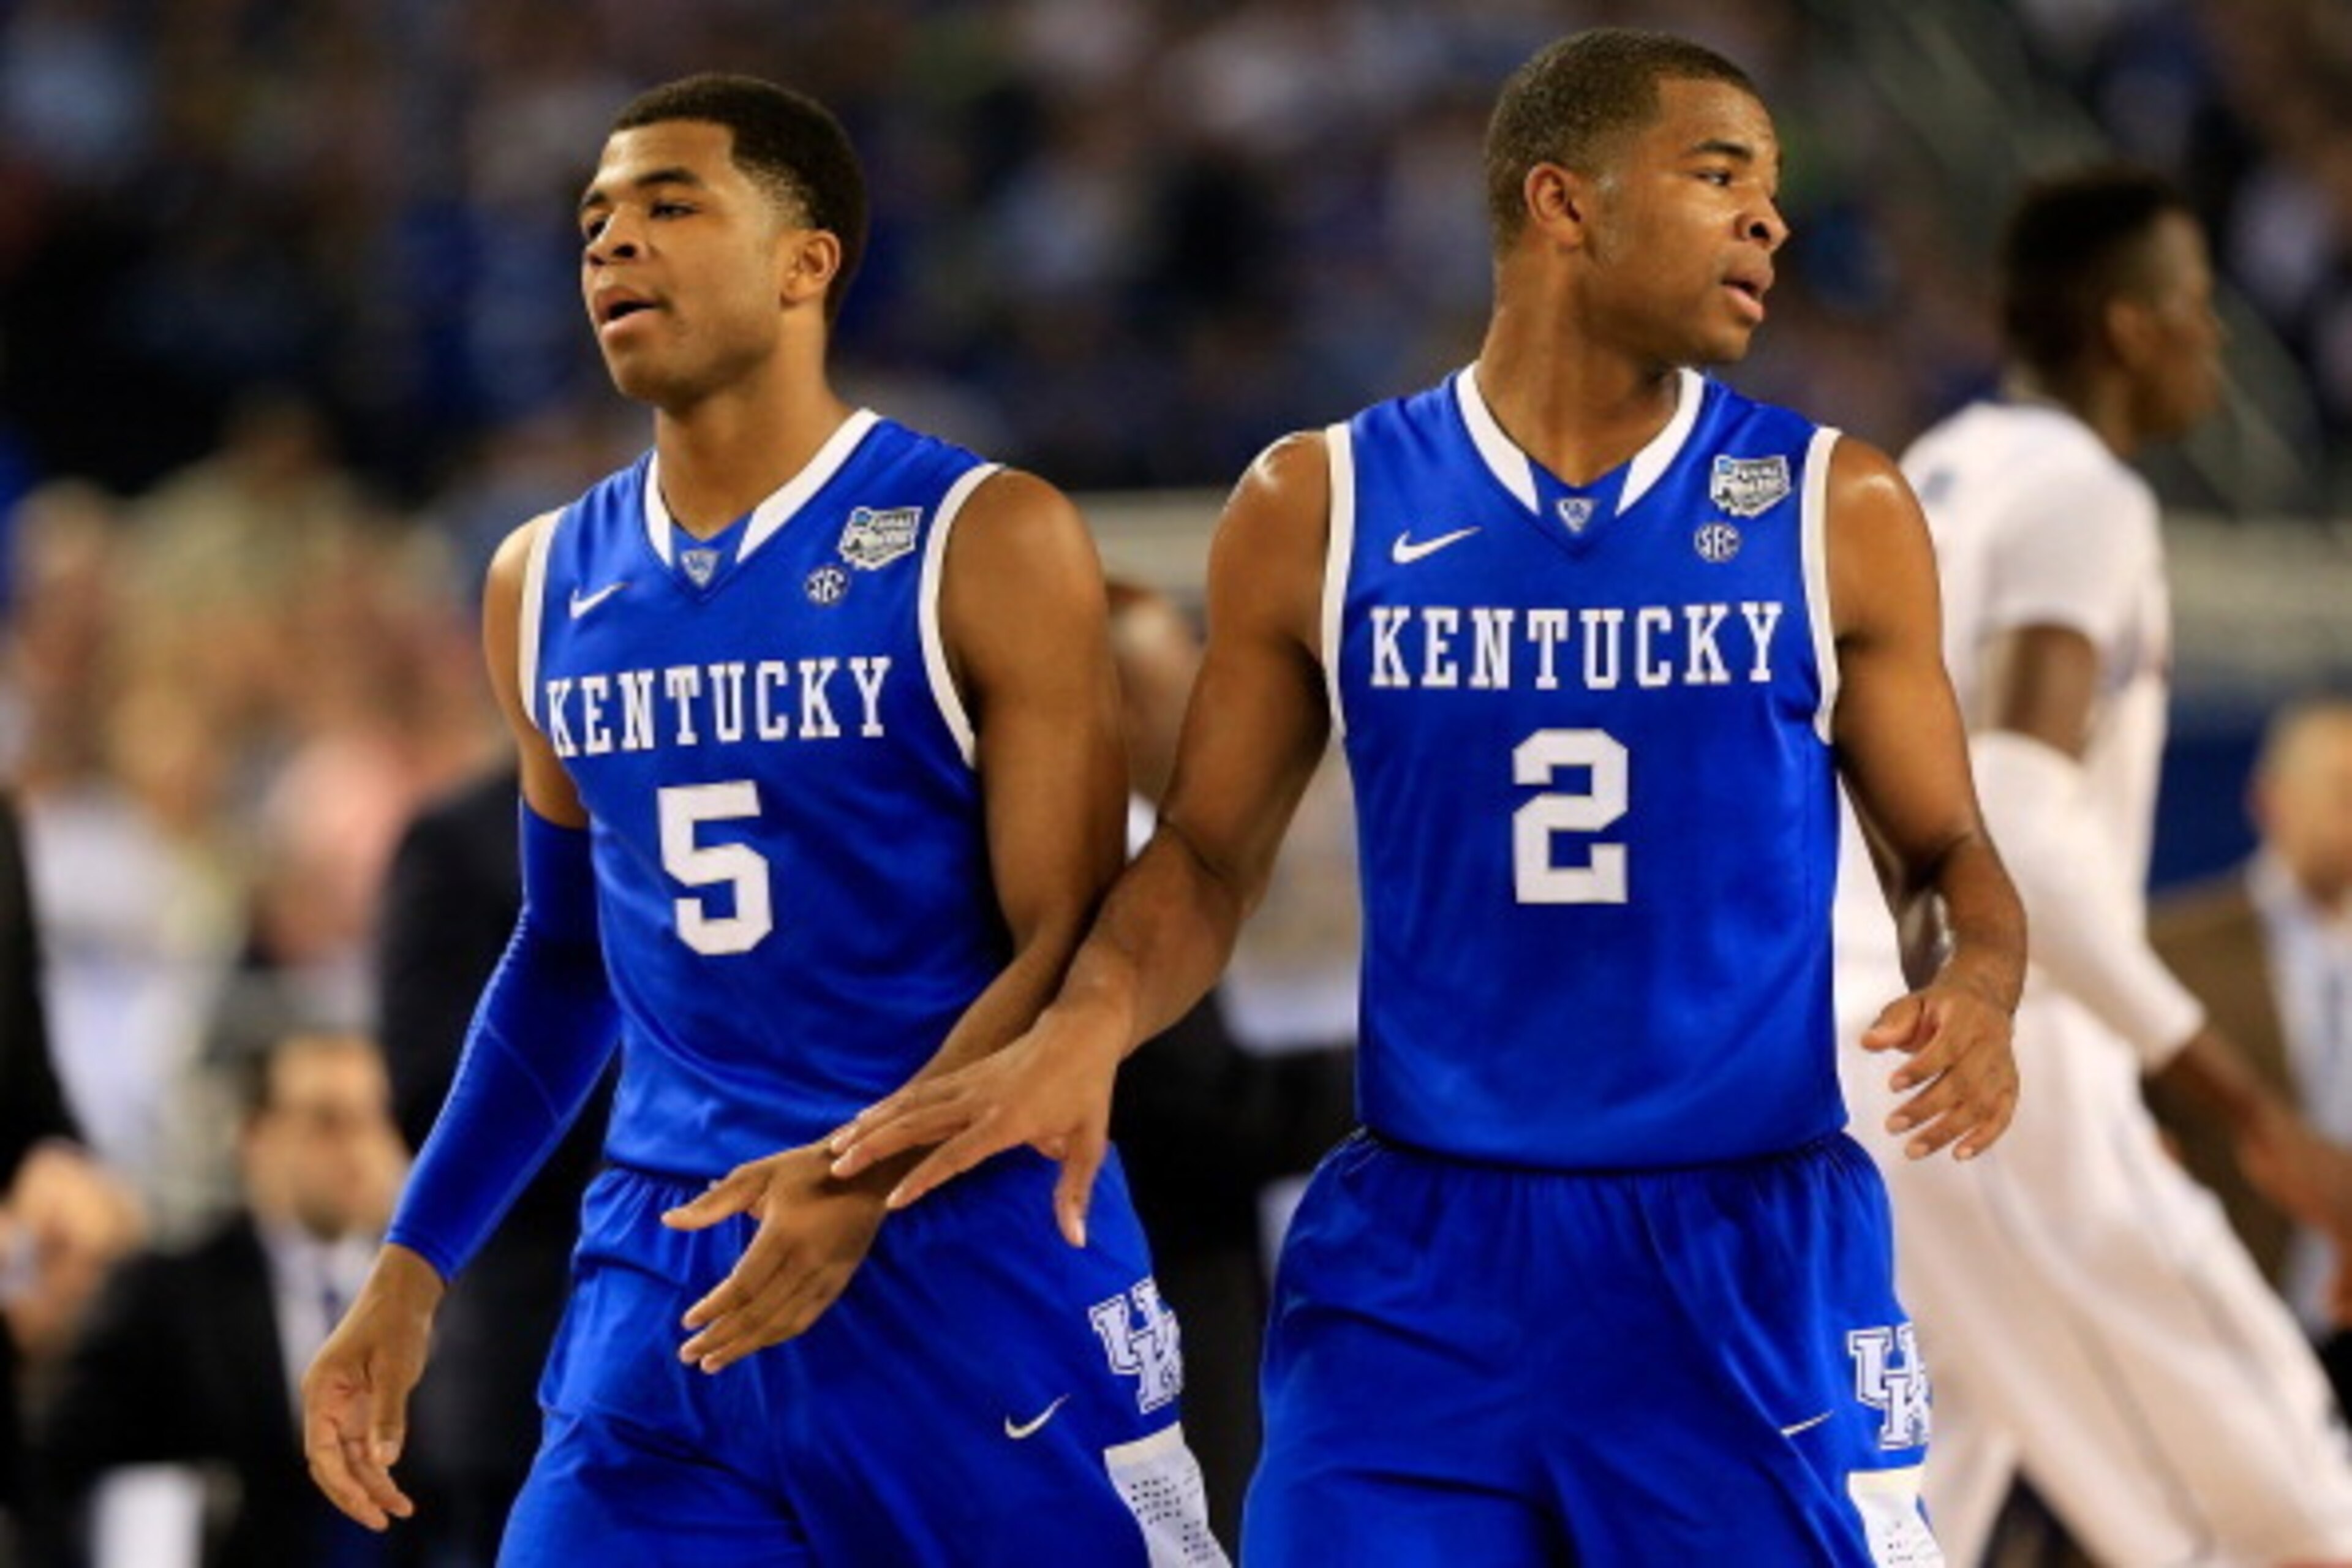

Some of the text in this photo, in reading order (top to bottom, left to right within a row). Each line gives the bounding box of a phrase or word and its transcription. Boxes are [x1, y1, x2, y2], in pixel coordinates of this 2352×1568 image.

[546, 657, 891, 758] KENTUCKY
[1370, 602, 1783, 690] KENTUCKY
[657, 780, 772, 955] 5
[1513, 729, 1628, 903] 2
[1088, 1276, 1183, 1414] UK
[1847, 1322, 1932, 1450] UK
